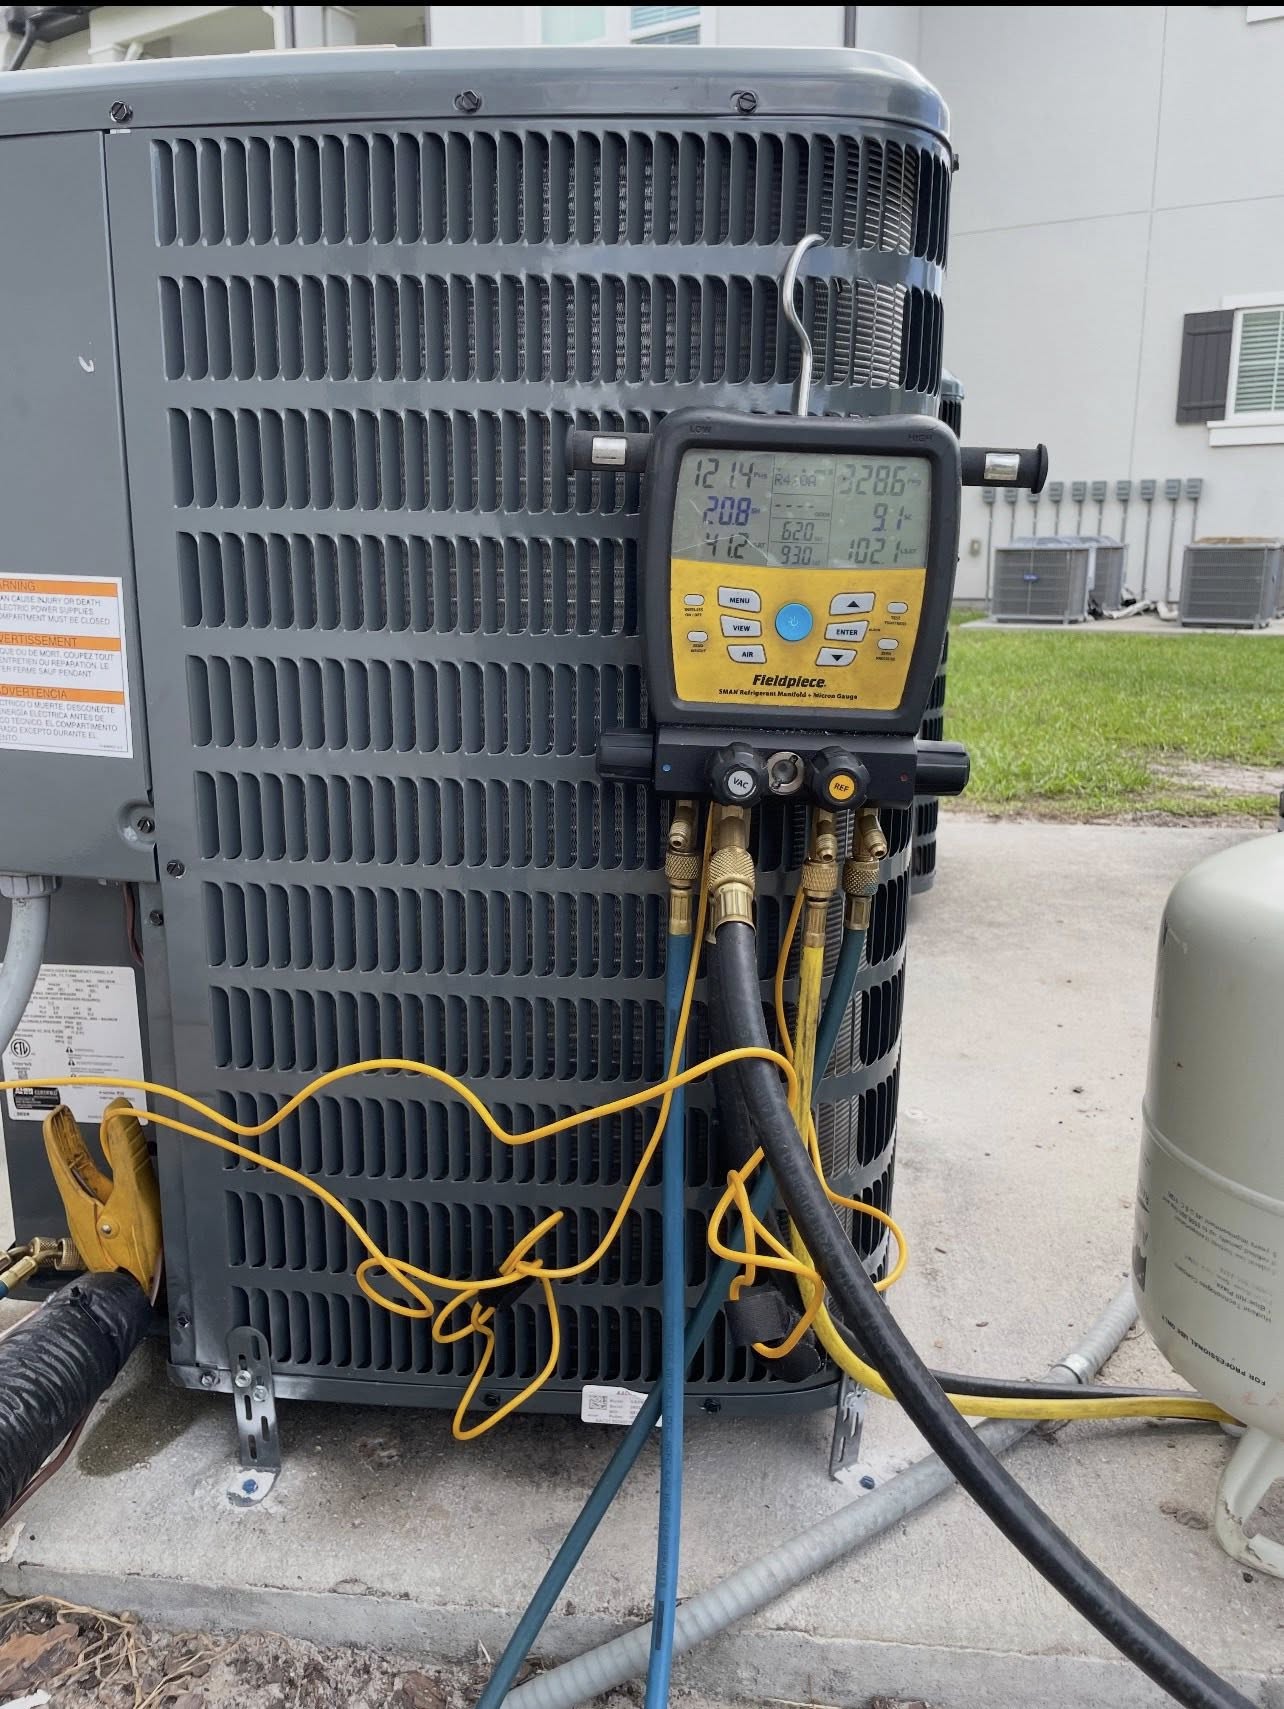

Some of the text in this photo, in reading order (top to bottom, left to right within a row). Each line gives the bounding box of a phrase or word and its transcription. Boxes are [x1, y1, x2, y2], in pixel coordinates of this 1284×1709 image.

[690, 425, 712, 433] LOW
[11, 595, 36, 604] CAUSE
[37, 596, 61, 605] INJURY
[64, 597, 75, 605] OR
[729, 596, 751, 604] MENU
[31, 604, 59, 614] POWER
[48, 614, 68, 624] MUST
[70, 616, 80, 624] BE
[836, 628, 858, 636] ENTER
[752, 674, 826, 689] Fieldpiece
[0, 684, 68, 699] DVERTENCIA
[739, 690, 776, 698] Refrigerant
[837, 693, 858, 701] Gauge
[732, 776, 749, 790] VAC
[833, 782, 850, 793] REF
[1176, 1326, 1190, 1341] USE
[1190, 1339, 1247, 1377] PROFESSIONAL
[1249, 1373, 1267, 1386] FOR
